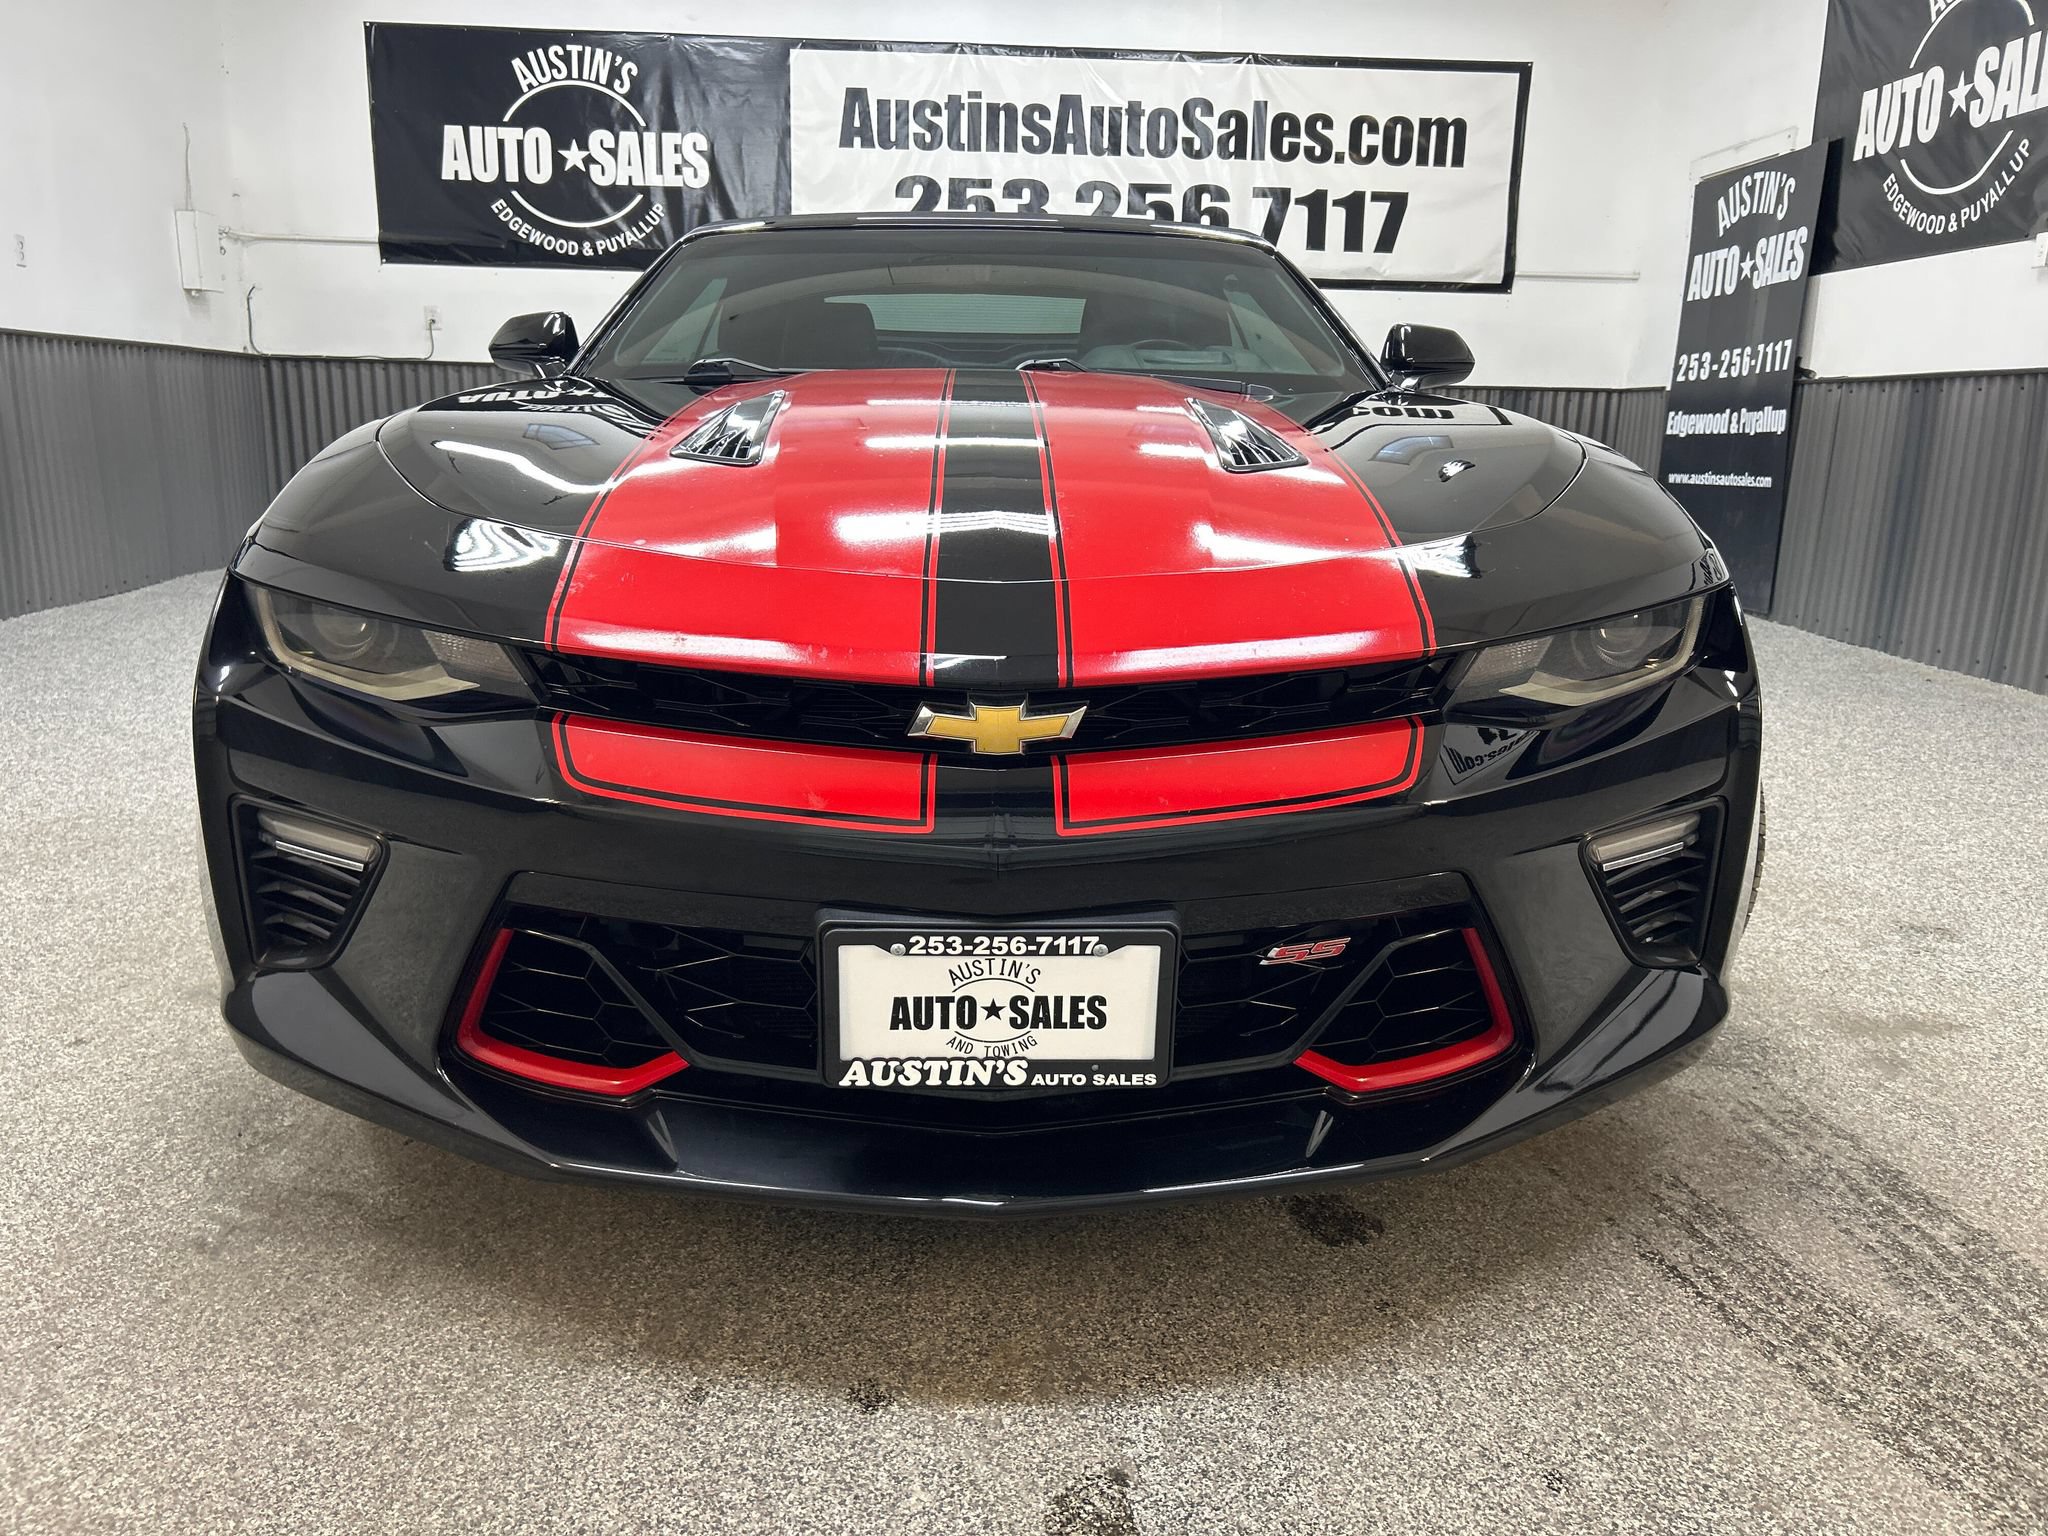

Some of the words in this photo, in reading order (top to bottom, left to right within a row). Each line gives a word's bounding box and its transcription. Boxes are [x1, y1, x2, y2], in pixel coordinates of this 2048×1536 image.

[511, 44, 638, 95] AUSTIN'S
[838, 86, 1468, 169] AustinsAutoSales.com
[1853, 66, 1945, 162] AUTO
[440, 125, 553, 186] AUTO
[588, 131, 710, 189] SALES
[1716, 170, 1796, 237] AUSTIN'S
[1882, 172, 1946, 235] EDGEWOOD
[1948, 212, 1958, 233] &
[1960, 138, 2030, 229] PUYALLUP
[491, 199, 579, 256] EDGEWOOD
[582, 241, 595, 257] &
[596, 203, 666, 256] PUYALLUP
[1686, 245, 1740, 302] AUTO
[1752, 226, 1808, 290] SALES
[1676, 339, 1792, 382] 253-256-7117
[1666, 408, 1730, 437] Edgewood
[1730, 412, 1739, 435] &
[1739, 406, 1787, 436] Puyallup
[1668, 471, 1772, 488] www.austinsautosales.com
[908, 936, 1099, 956] 253-256-7117
[1260, 937, 1351, 965] SS
[948, 958, 1041, 986] AUSTIN'S
[889, 995, 978, 1031] AUTO
[1009, 994, 1108, 1031] SALES
[946, 1036, 974, 1056] AND
[984, 1034, 1038, 1058] TOWING
[838, 1060, 1030, 1087] AUSTIN'S
[1031, 1073, 1087, 1087] AUTO
[1092, 1073, 1157, 1087] SALES
